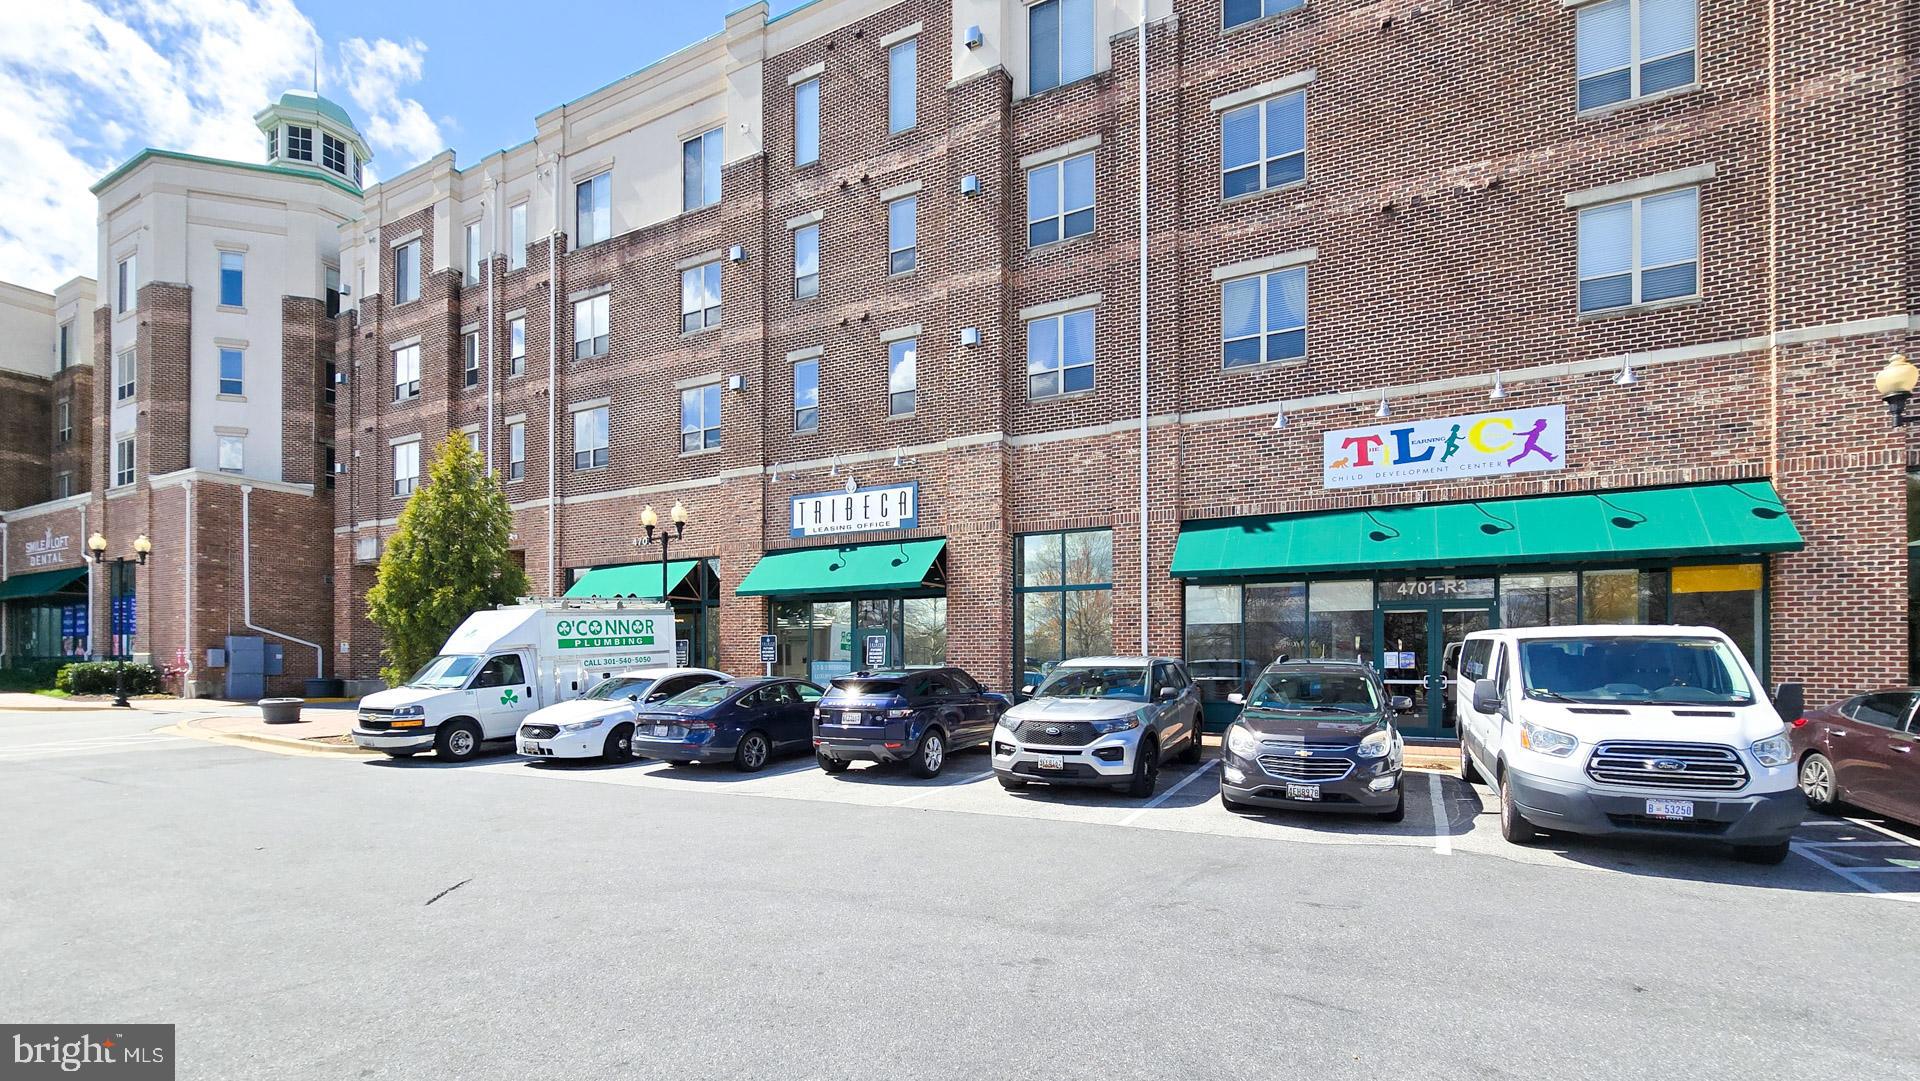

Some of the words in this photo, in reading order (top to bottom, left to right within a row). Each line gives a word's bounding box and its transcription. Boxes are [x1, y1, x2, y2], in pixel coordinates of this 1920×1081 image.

[1332, 474, 1363, 482] CHILD
[1375, 466, 1449, 479] DEVELOPMENT
[1459, 461, 1503, 471] CENTER
[799, 490, 907, 526] TRIBECA
[813, 524, 852, 533] LEASING
[856, 520, 891, 529] OFFICE
[25, 540, 46, 553] SMILE
[50, 535, 70, 549] LOFT
[30, 552, 64, 567] DENTAL
[1397, 580, 1468, 595] 4701-R3
[556, 619, 655, 637] O'CONNOR
[574, 637, 644, 647] PLUMBING
[603, 656, 652, 666] 301-540-5050
[1664, 804, 1692, 816] 53250
